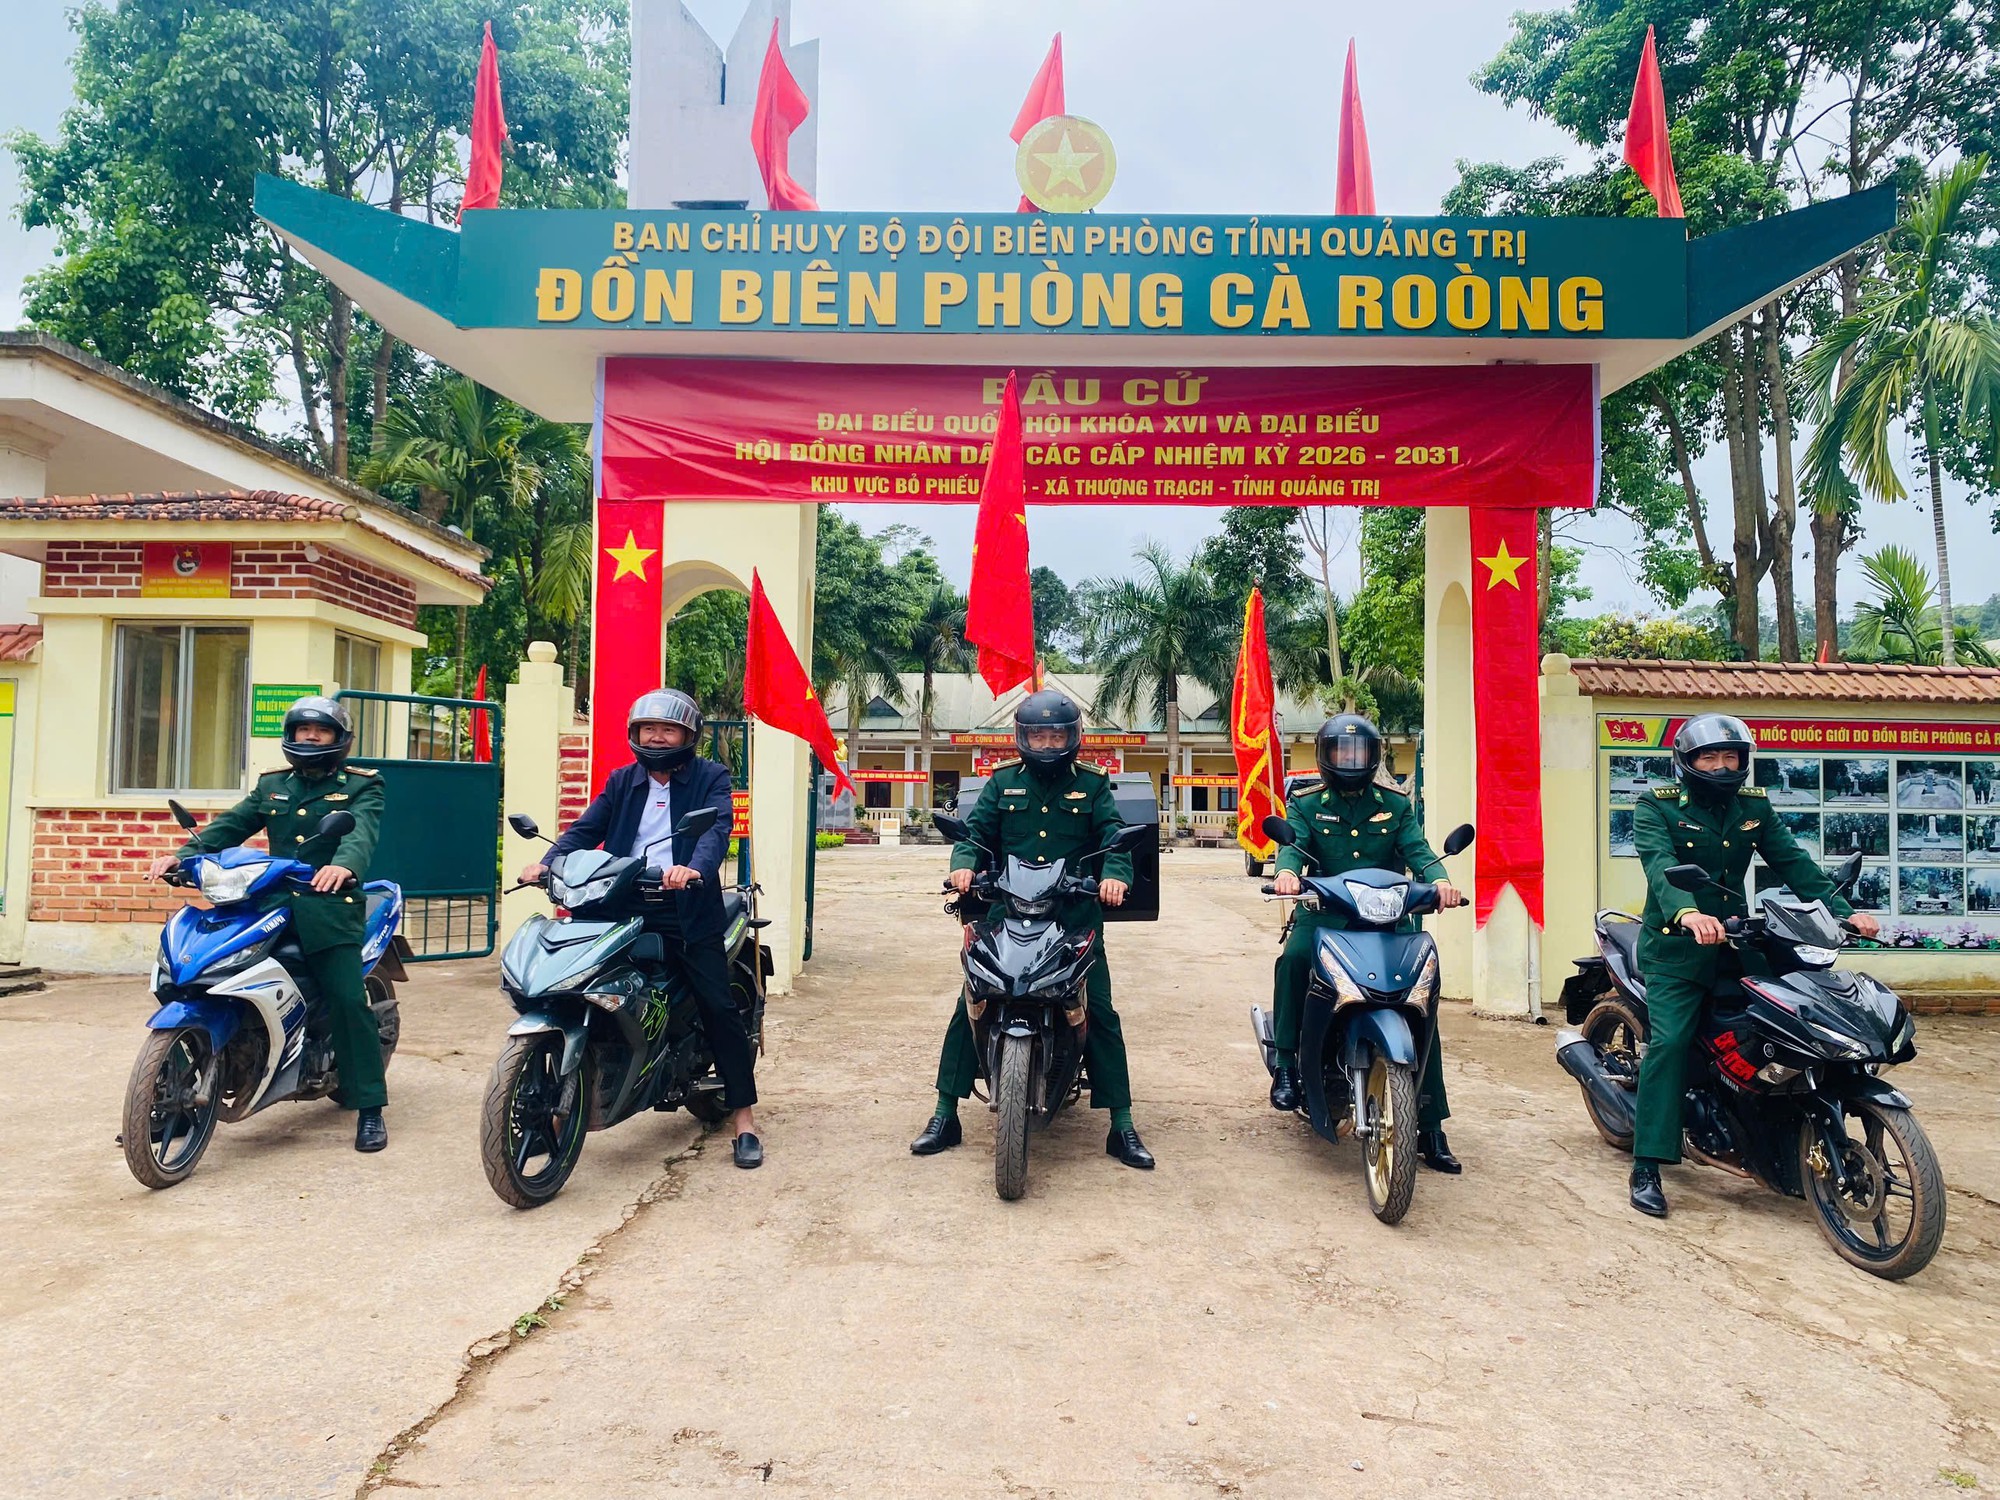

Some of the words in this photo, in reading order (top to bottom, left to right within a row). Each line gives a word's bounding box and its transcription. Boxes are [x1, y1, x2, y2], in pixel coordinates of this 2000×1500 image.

[614, 222, 690, 252] BAN
[701, 213, 760, 252] CHỈ
[771, 224, 846, 253] HUY
[858, 217, 907, 261] BỘ
[917, 219, 982, 261] ĐỘI
[993, 219, 1074, 255] BIÊN
[1085, 218, 1213, 256] PHÒNG
[1225, 216, 1311, 257] TỈNH
[1321, 218, 1458, 258] QUẢNG
[1467, 229, 1526, 266] TRỊ
[535, 251, 694, 323] ĐỒN
[719, 259, 898, 327] BIÊN
[923, 259, 1184, 329] PHÒNG
[1209, 262, 1312, 330] CÀ
[1338, 262, 1604, 332] ROÒNG
[1122, 370, 1209, 406] CỬ
[816, 412, 863, 435] ĐẠI
[871, 407, 934, 433] BIỂU
[943, 409, 1000, 435] QUỐ
[1025, 412, 1071, 437] HỘI
[1080, 412, 1155, 434] KHÓA
[1163, 415, 1207, 433] XVI
[1216, 412, 1252, 433] VÀ
[1260, 414, 1307, 437] ĐẠI
[1316, 408, 1380, 434] BIỂU
[735, 439, 781, 464] HỘI
[789, 437, 865, 464] ĐỒNG
[874, 441, 952, 464] NHÂN
[960, 442, 993, 464] DÂ
[1026, 442, 1081, 465] CÁC
[1090, 440, 1145, 465] CẤP
[1154, 443, 1245, 469] NHIỆM
[1254, 443, 1290, 465] KỲ
[1298, 446, 1366, 465] 2026
[1395, 446, 1459, 465] 2031
[811, 476, 848, 493] KHU
[854, 476, 890, 497] VỰC
[895, 474, 920, 494] BỎ
[925, 473, 980, 495] PHIẾU
[1045, 477, 1070, 495] XÃ
[1075, 478, 1148, 498] THƯỢNG
[1154, 479, 1214, 498] TRẠCH
[1232, 475, 1275, 496] TỈNH
[1281, 475, 1345, 496] QUẢNG
[1351, 479, 1380, 499] TRỊ
[1760, 724, 1788, 742] MỐC
[1790, 724, 1823, 743] QUỐC
[1825, 726, 1850, 743] GIỚI
[1853, 729, 1869, 743] DO
[1872, 727, 1898, 744] ĐỒN
[1900, 727, 1929, 744] BIÊN
[1932, 728, 1972, 745] PHÒNG
[1975, 729, 1992, 745] CÀ
[260, 914, 286, 934] YAMAHA
[1720, 1073, 1740, 1093] YAMAHA
